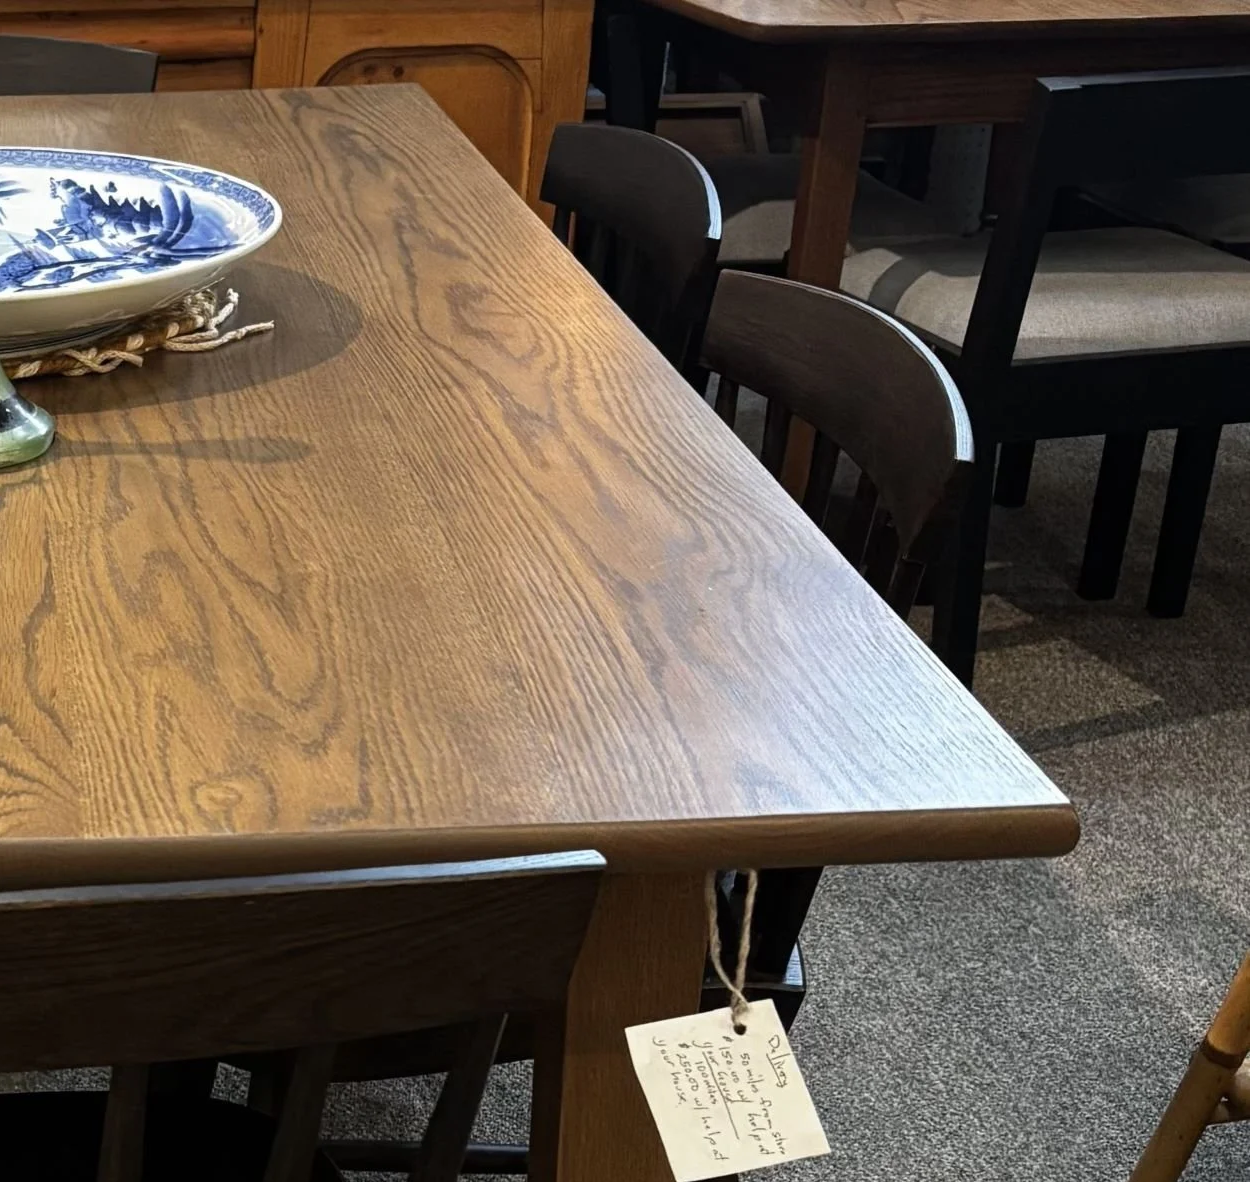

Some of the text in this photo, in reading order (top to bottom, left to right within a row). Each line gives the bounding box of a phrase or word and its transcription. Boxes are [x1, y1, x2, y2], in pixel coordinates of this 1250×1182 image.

[652, 1036, 675, 1067] your
[692, 1040, 718, 1068] your
[768, 1034, 790, 1088] Delivery
[759, 1097, 773, 1129] from
[701, 1117, 722, 1145] help
[713, 1148, 729, 1161] at
[747, 1113, 766, 1141] help
[758, 1141, 775, 1155] at
